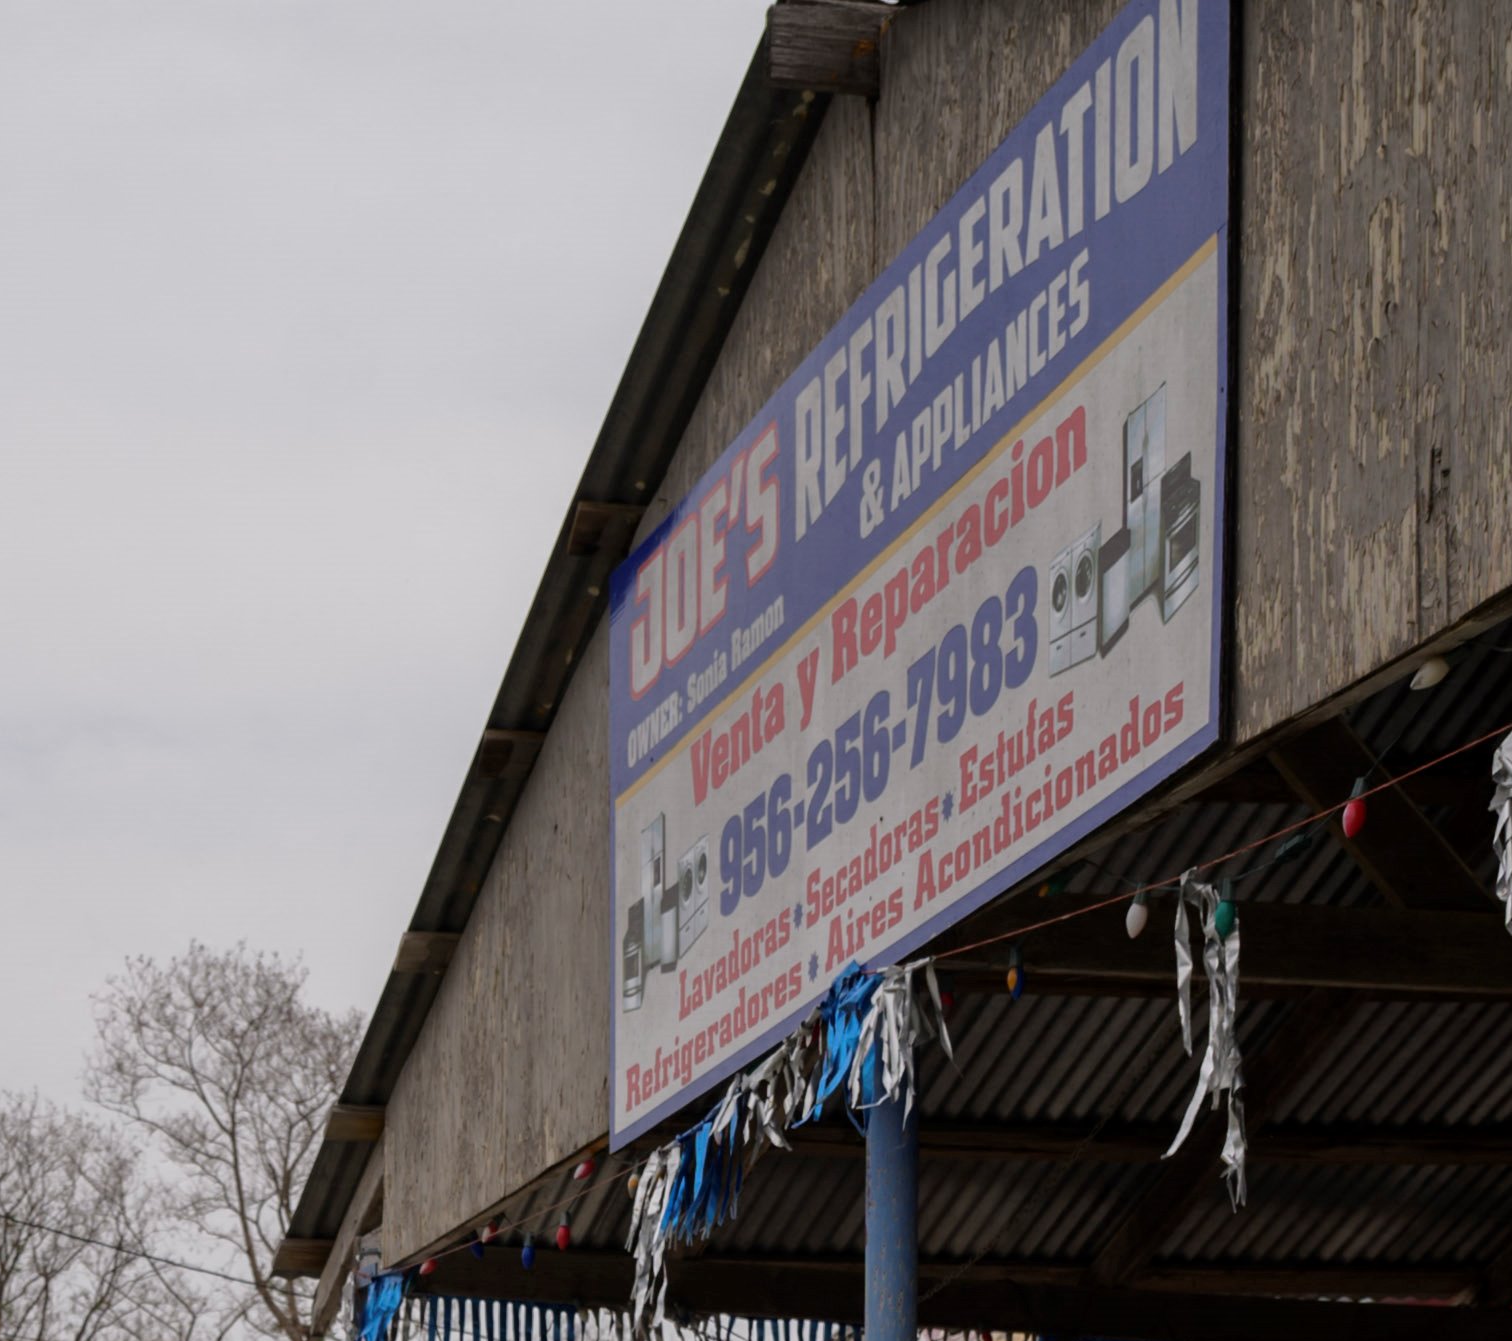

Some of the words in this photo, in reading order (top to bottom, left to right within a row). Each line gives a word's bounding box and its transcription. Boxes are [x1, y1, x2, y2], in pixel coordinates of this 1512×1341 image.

[630, 419, 779, 701] JOE'S
[794, 0, 1197, 541] REFRIGERATION
[859, 458, 884, 539] &
[890, 247, 1090, 513] APPLIANCES
[628, 690, 683, 769] OWNER:
[687, 649, 728, 714] Sonia
[731, 594, 785, 673] Ramon
[690, 682, 785, 807] Venta
[797, 646, 820, 733] y
[831, 404, 1088, 685] Reparacion
[719, 565, 1039, 916] 956-256-7983
[626, 960, 803, 1113] Refrigeradores
[825, 894, 903, 971] Aires
[914, 682, 1185, 905] Acondicionados
[680, 908, 791, 1022] Lavadoras
[806, 796, 940, 928] Secadoras
[960, 691, 1074, 813] Estufas
